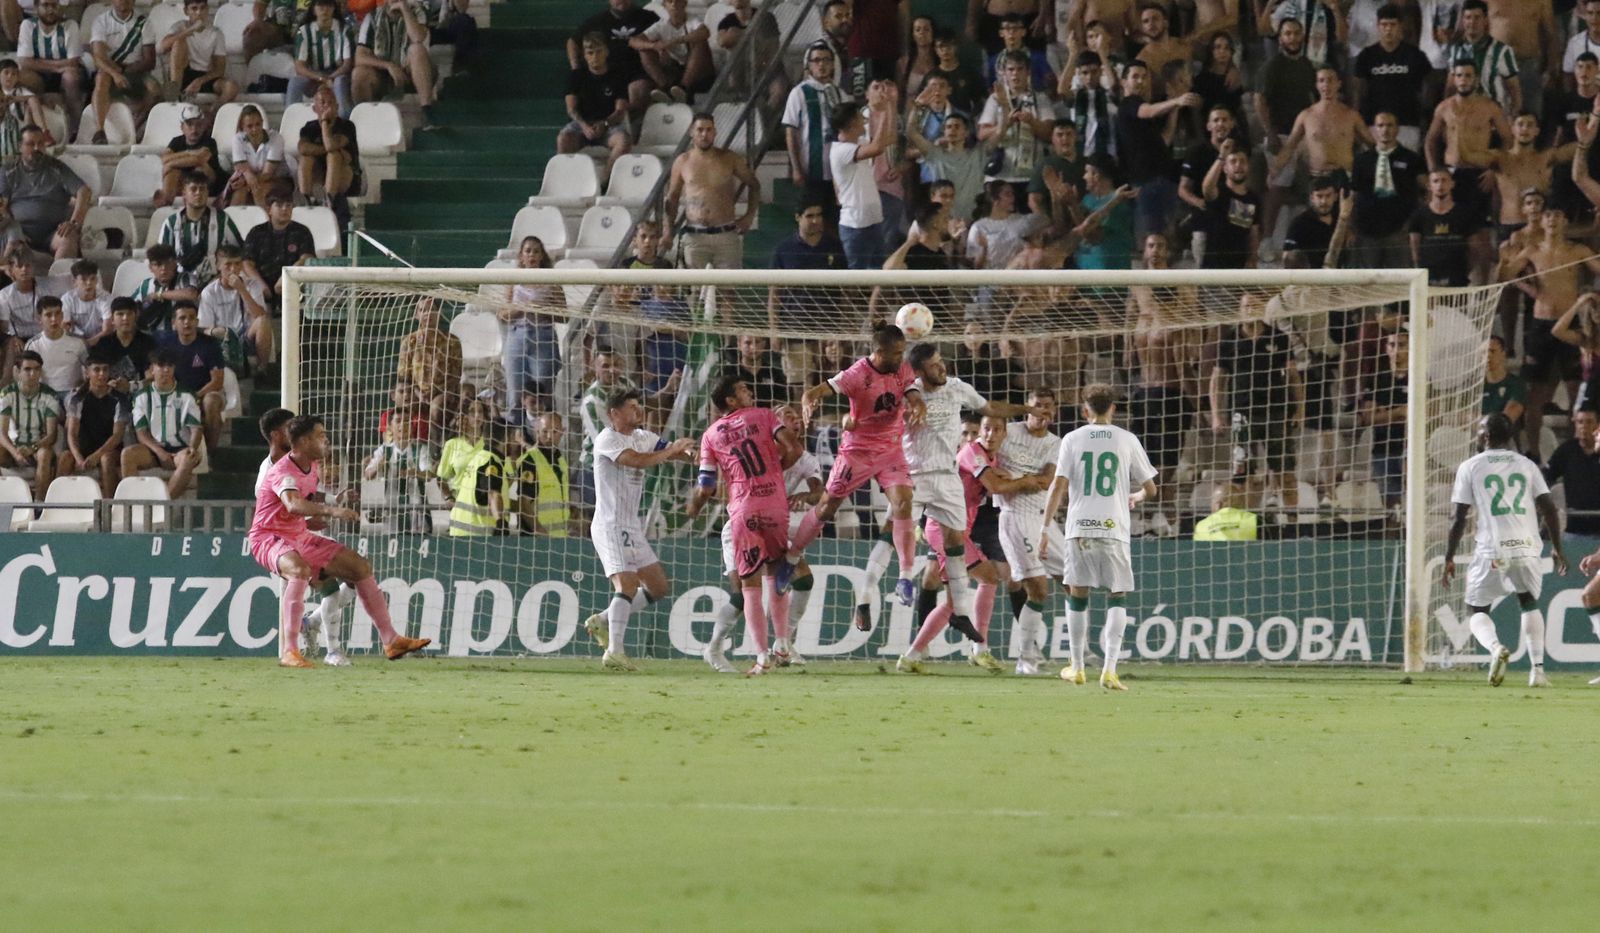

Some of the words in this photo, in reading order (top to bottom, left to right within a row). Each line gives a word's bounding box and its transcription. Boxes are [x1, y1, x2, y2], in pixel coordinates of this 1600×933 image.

[730, 439, 767, 480] 10
[1080, 451, 1120, 497] 18
[1484, 472, 1527, 517] 22
[151, 536, 251, 557] DESD
[357, 538, 430, 558] 904
[0, 543, 580, 656] Cruzcmpo
